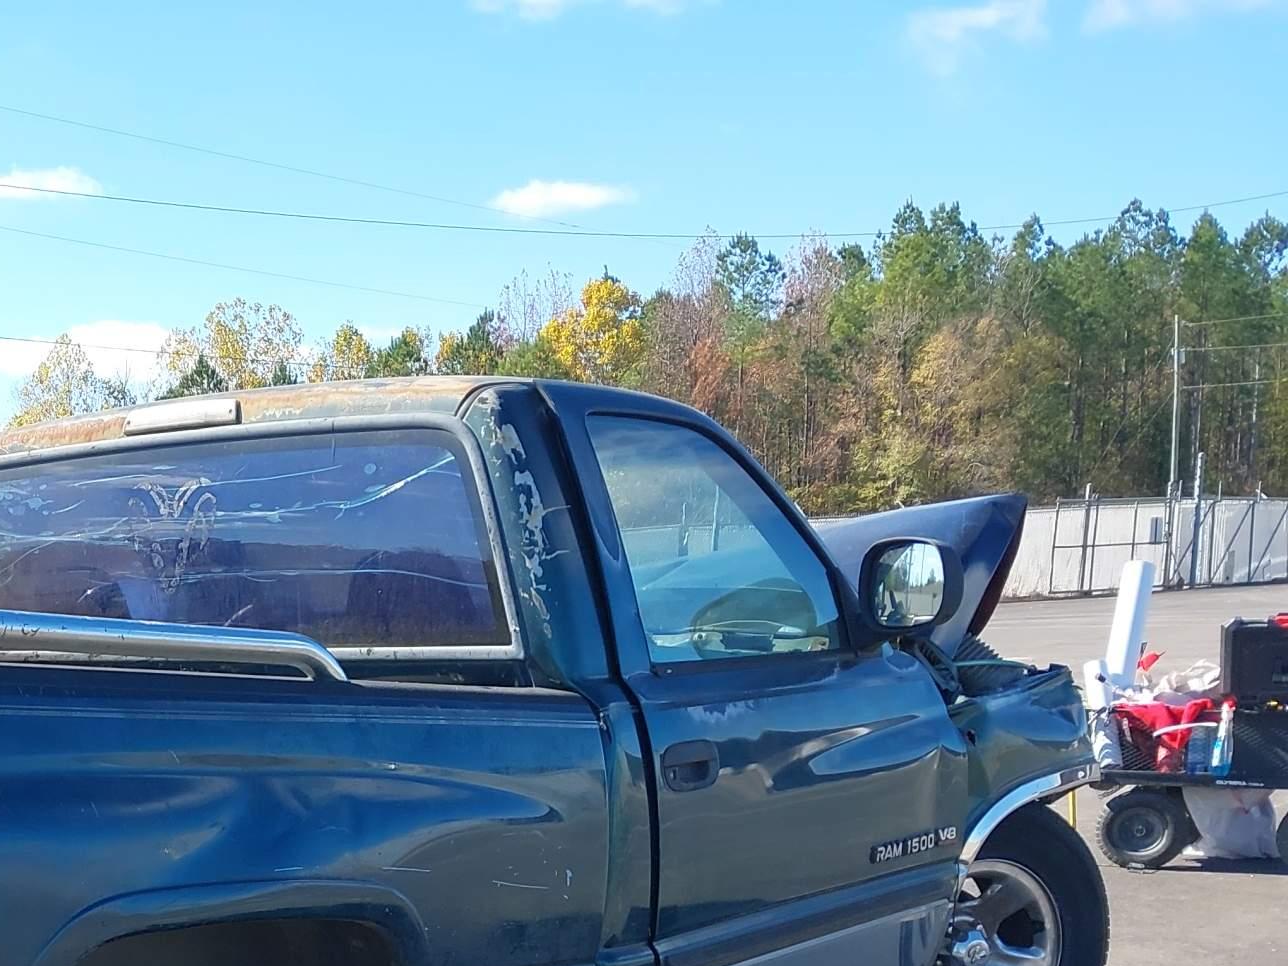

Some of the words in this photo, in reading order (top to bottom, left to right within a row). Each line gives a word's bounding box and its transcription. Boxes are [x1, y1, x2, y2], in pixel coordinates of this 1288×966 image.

[876, 843, 903, 863] RAM
[907, 834, 935, 854] 1500
[938, 827, 957, 841] V8
